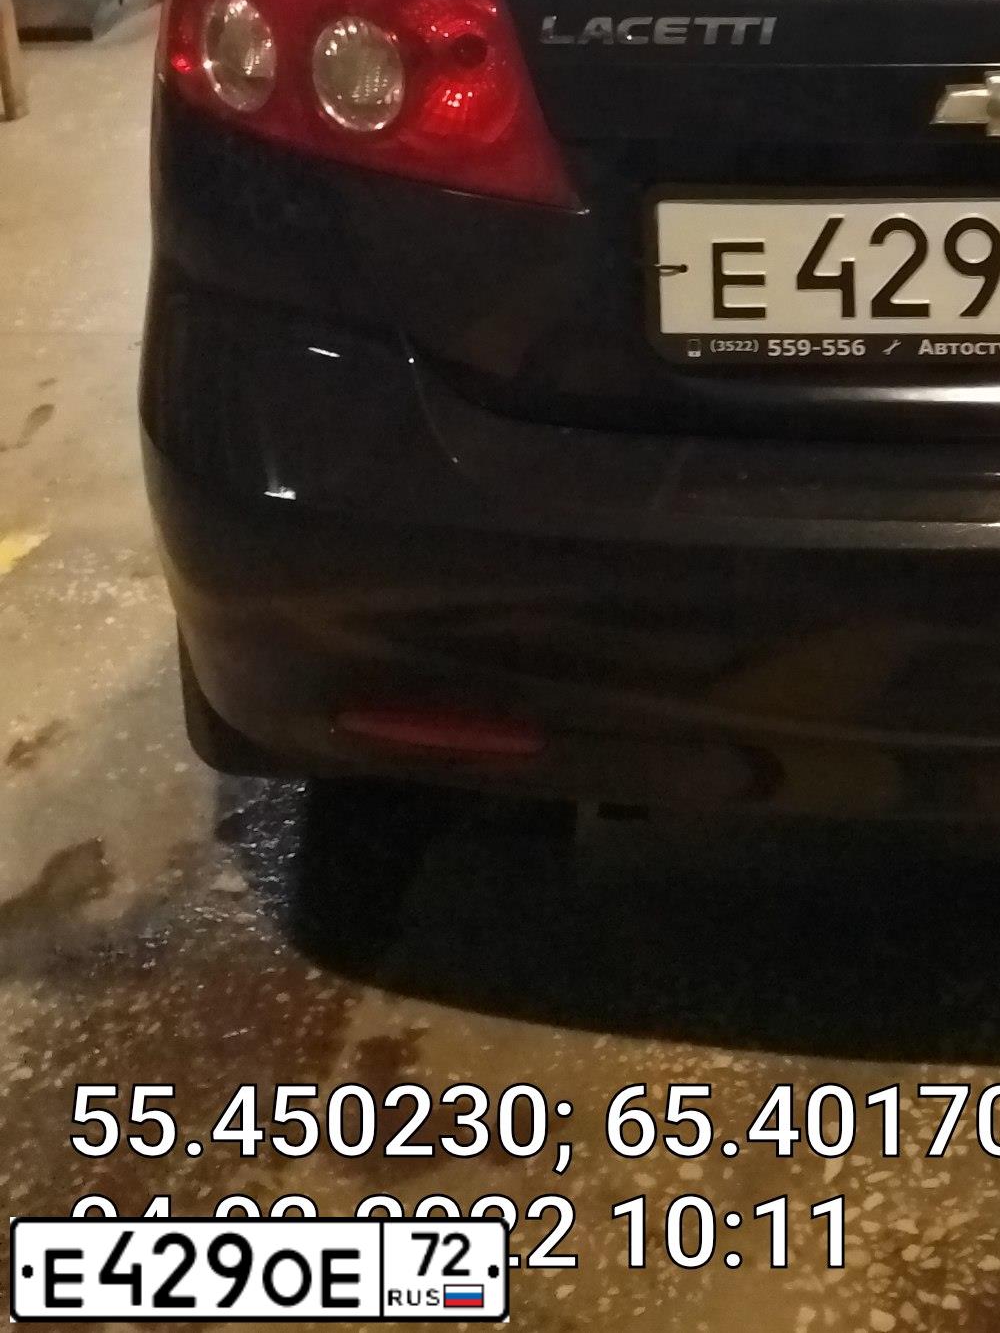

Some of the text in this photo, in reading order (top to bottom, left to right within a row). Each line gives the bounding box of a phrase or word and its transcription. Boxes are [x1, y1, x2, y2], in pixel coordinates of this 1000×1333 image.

[540, 16, 777, 45] LACETTI
[709, 338, 760, 354] (3522)
[767, 339, 867, 357] 559-556
